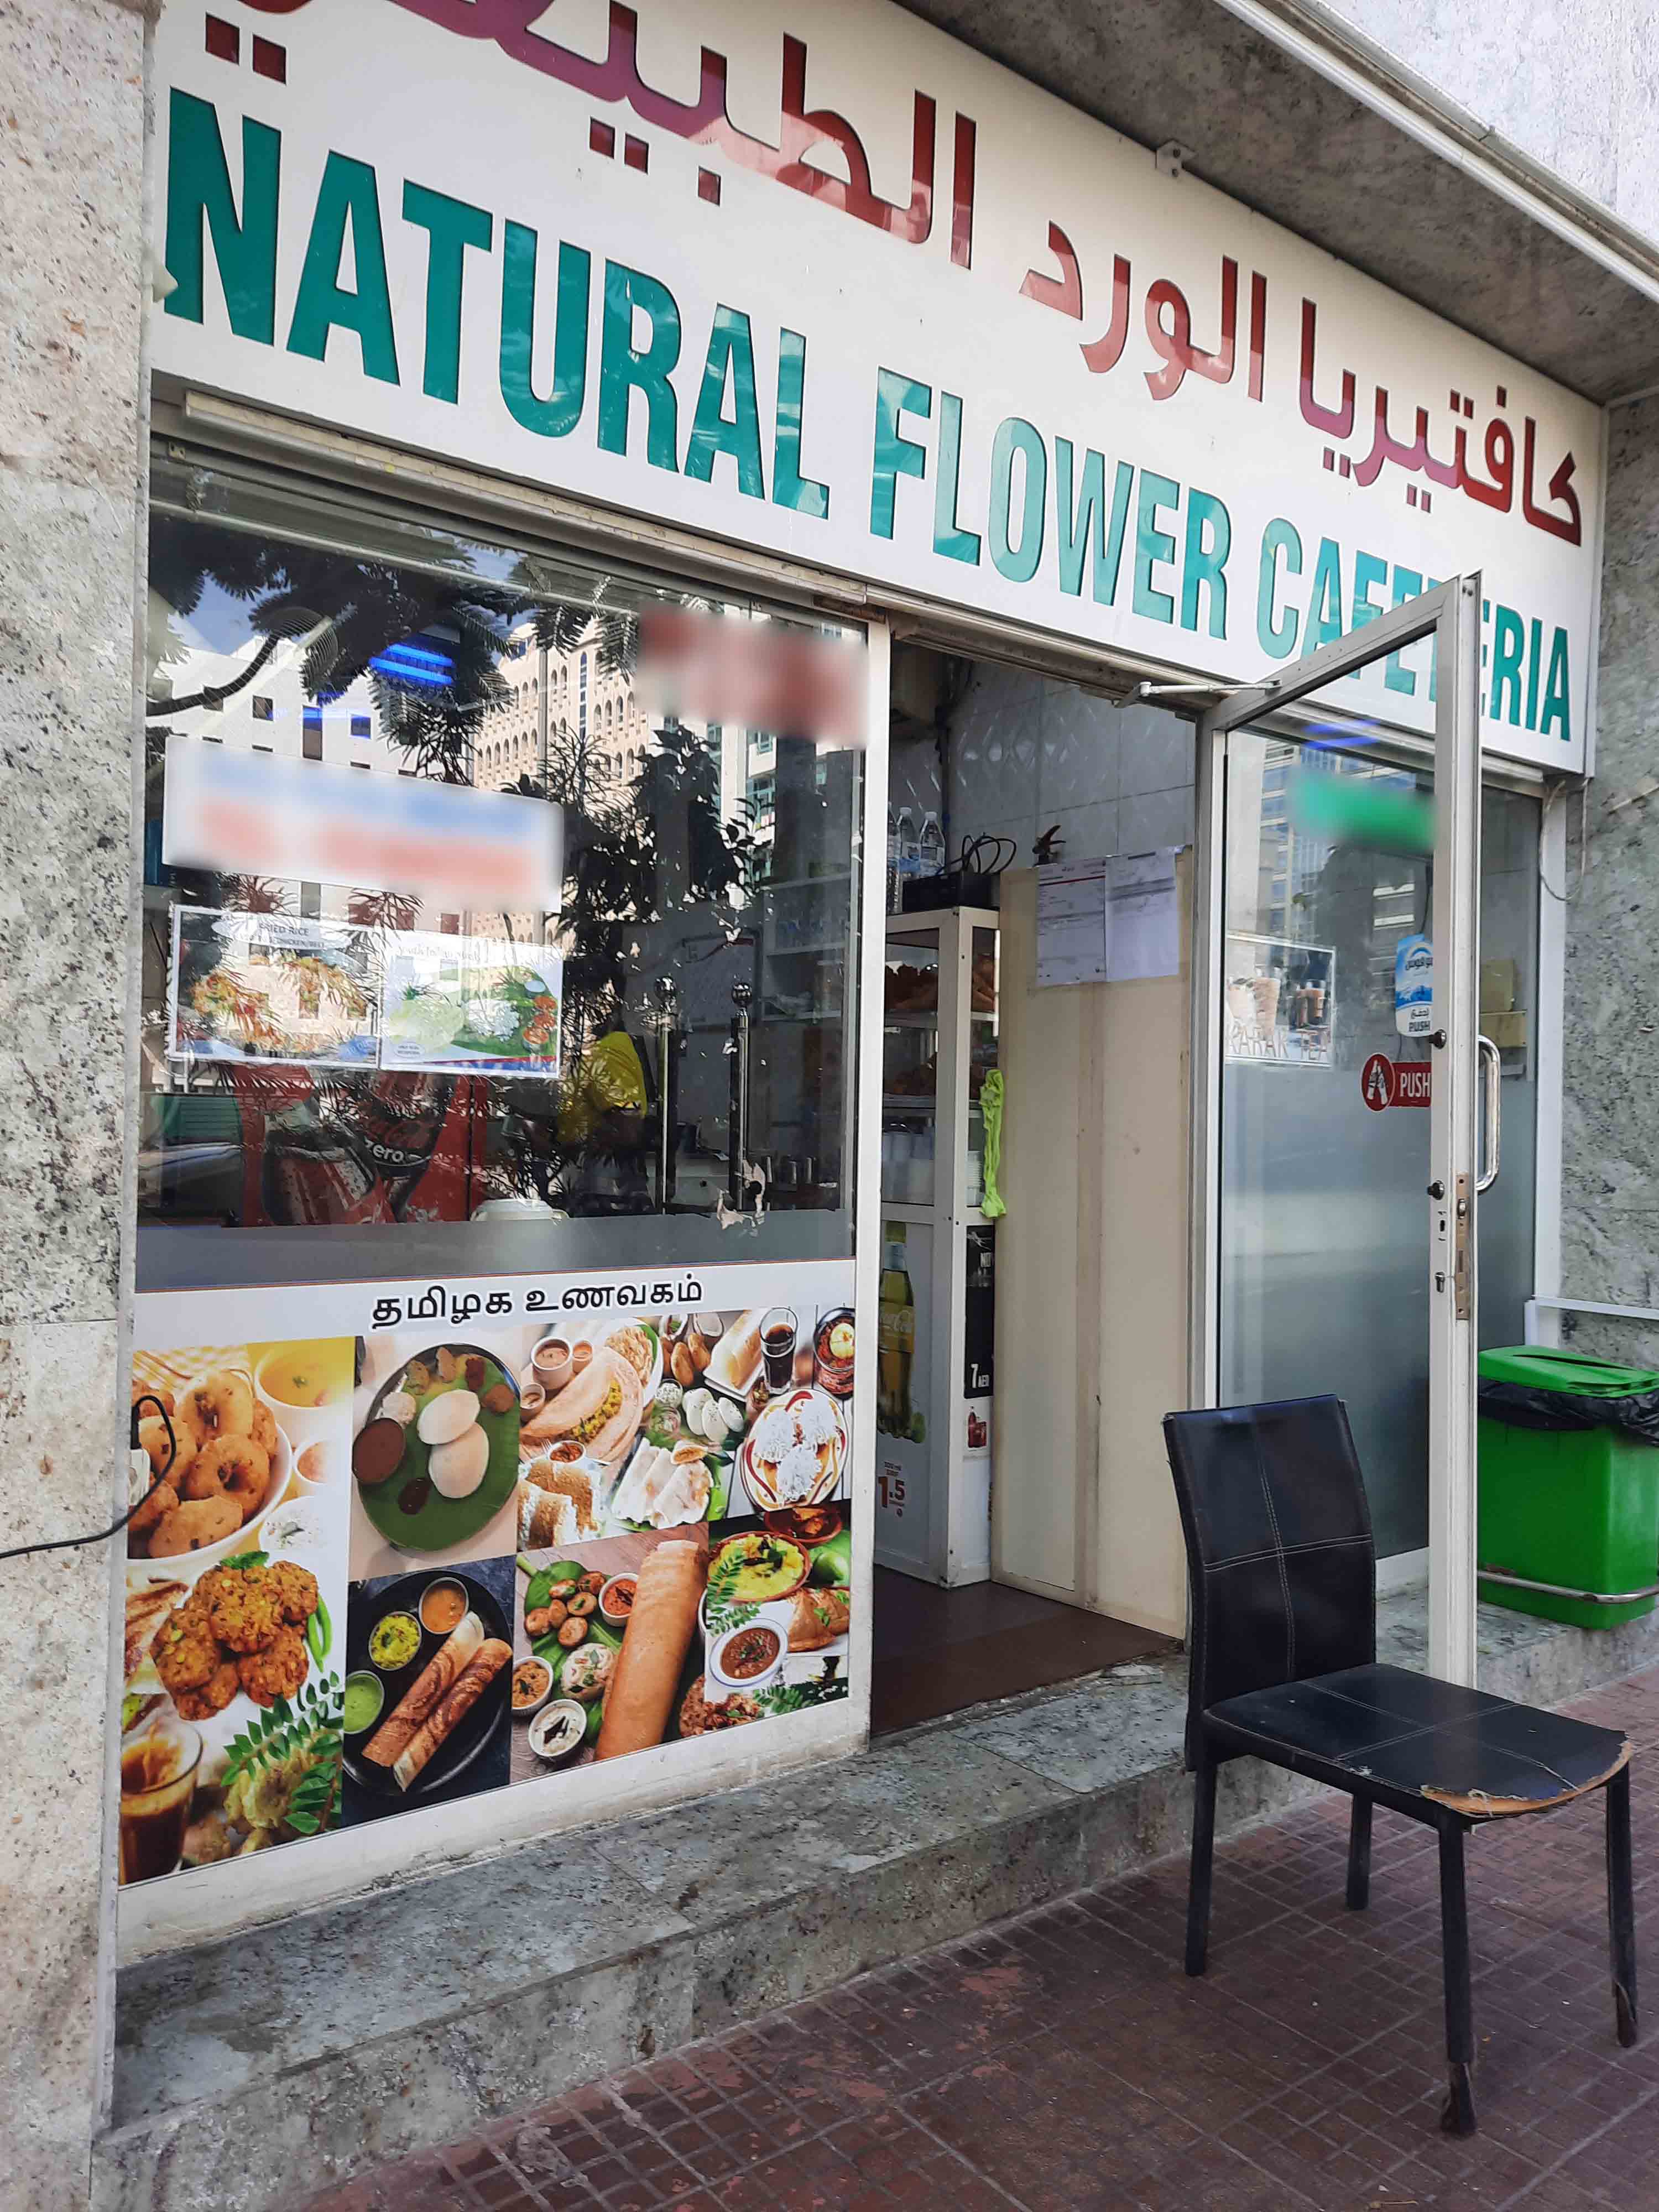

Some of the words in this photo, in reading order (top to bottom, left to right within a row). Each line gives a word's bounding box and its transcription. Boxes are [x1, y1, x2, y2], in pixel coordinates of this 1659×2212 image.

[1019, 220, 1267, 402] الورد
[164, 86, 830, 520] NATURAL
[870, 366, 1232, 640] FLOWER
[1256, 518, 1571, 742] CAFERIA
[1300, 298, 1582, 546] كافتيريا
[1400, 1072, 1431, 1097] PUSH
[1408, 1020, 1431, 1032] PUSH
[372, 1285, 513, 1329] தமிழக
[525, 1273, 702, 1312] உணவகம்
